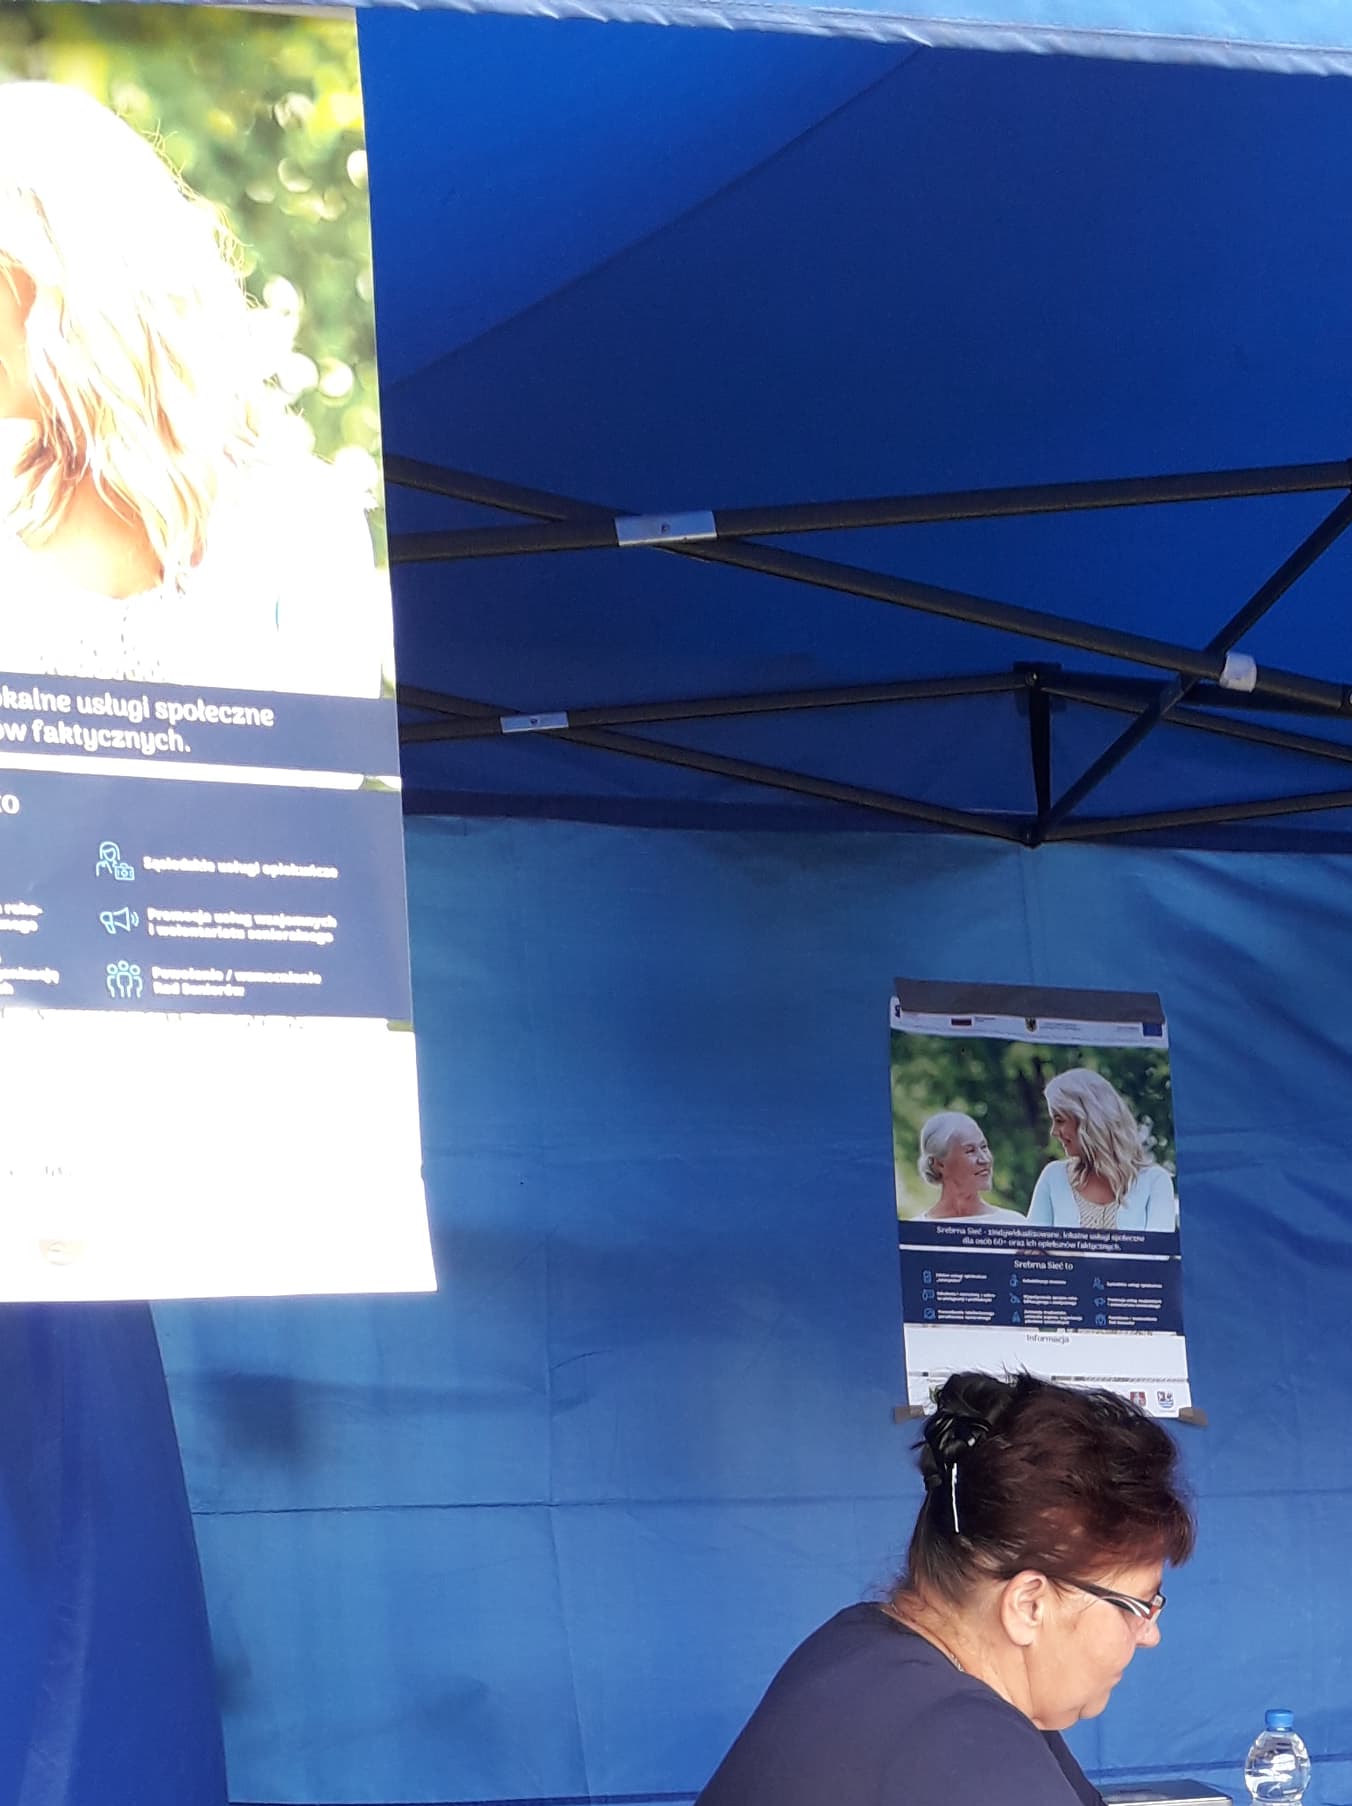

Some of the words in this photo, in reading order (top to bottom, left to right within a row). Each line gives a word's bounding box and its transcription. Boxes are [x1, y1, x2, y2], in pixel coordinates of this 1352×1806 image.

[0, 686, 71, 713] kalne
[77, 693, 149, 723] usługi
[155, 699, 273, 727] społeczne
[31, 719, 191, 755] faktycznych.
[1014, 1260, 1047, 1269] Srebrna
[1065, 1262, 1074, 1270] to
